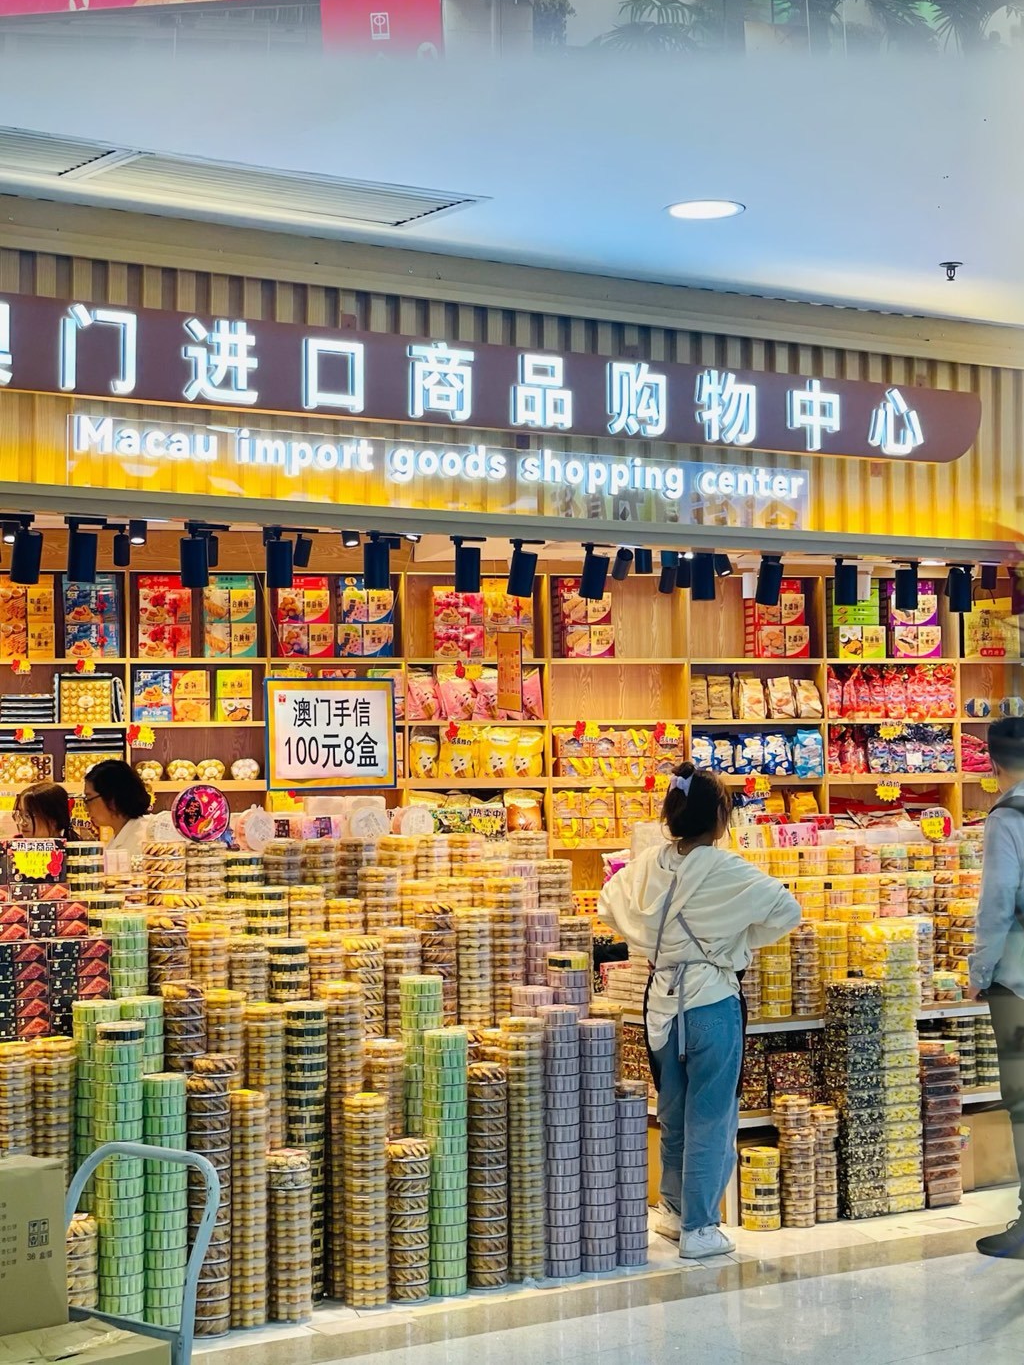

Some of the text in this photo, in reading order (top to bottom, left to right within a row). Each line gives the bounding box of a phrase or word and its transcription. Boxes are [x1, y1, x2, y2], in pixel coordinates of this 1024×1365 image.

[0, 301, 926, 456] 门进口商品购物中心
[74, 413, 806, 500] Macau import goods shopping center
[293, 697, 371, 728] 澳门手信
[284, 731, 379, 769] 100元8盒
[17, 841, 55, 852] 热卖商品
